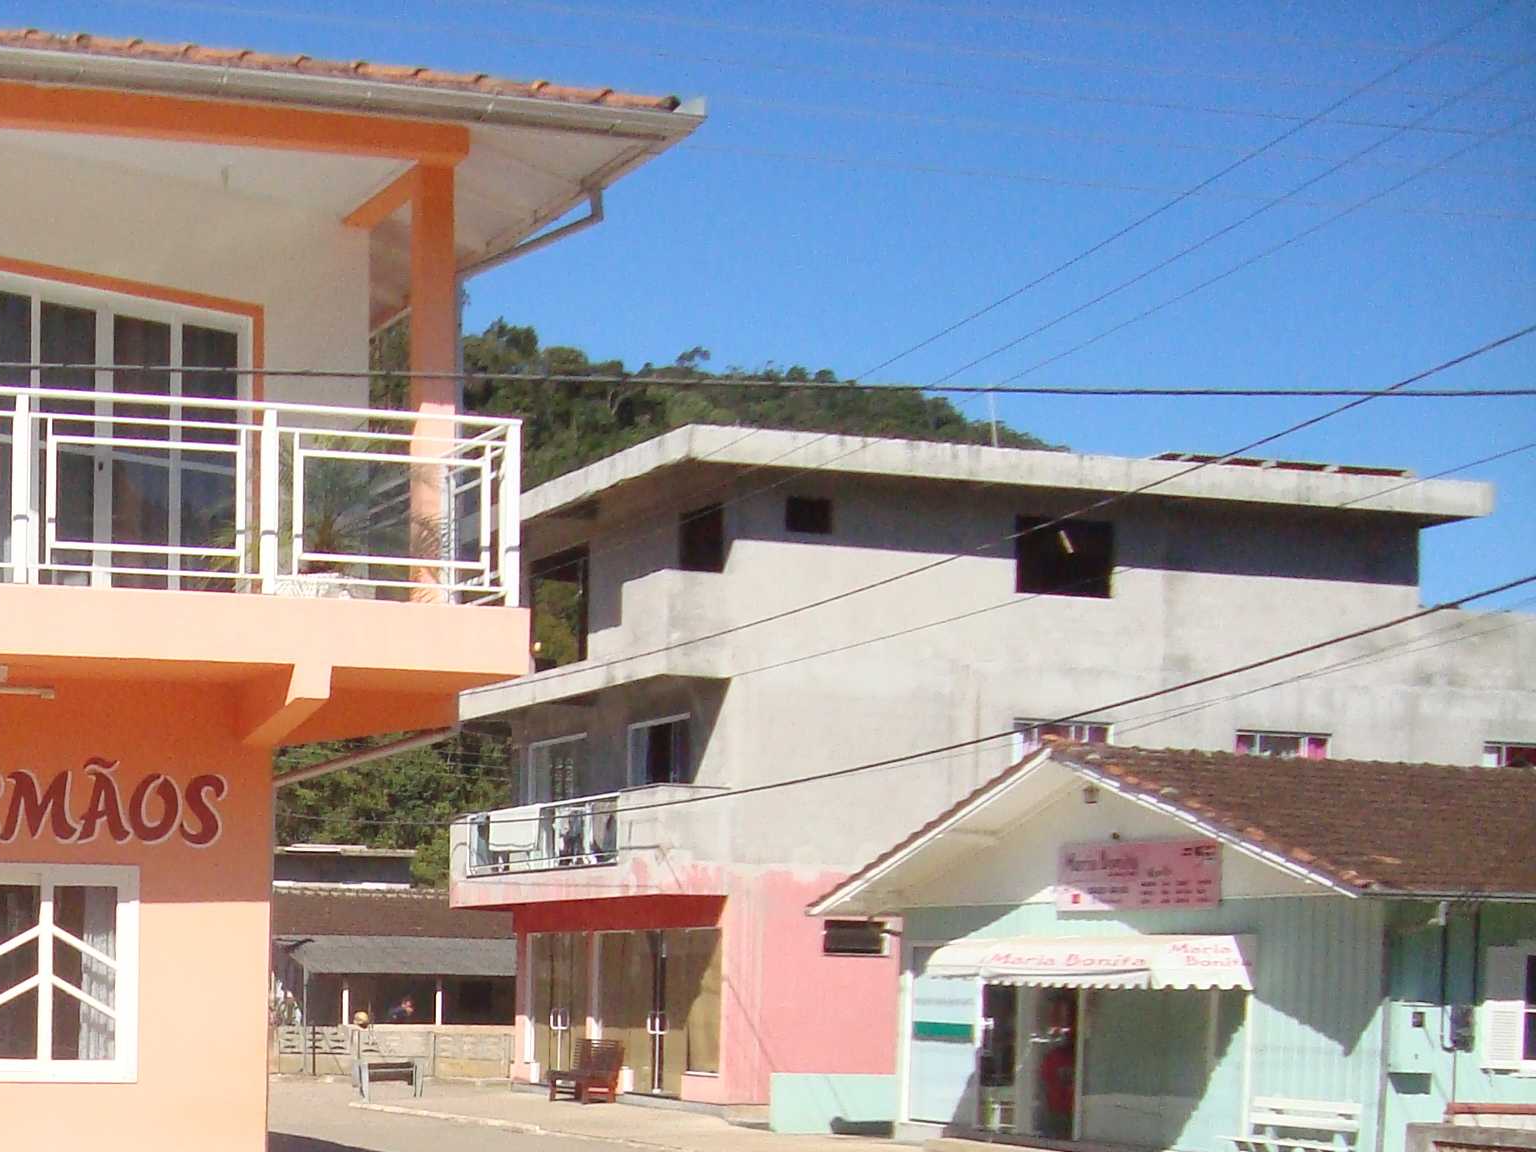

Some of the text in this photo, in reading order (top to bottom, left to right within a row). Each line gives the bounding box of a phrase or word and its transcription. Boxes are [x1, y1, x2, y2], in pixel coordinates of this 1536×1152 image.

[1168, 944, 1233, 955] Maria
[991, 953, 1147, 968] Maria Bonita
